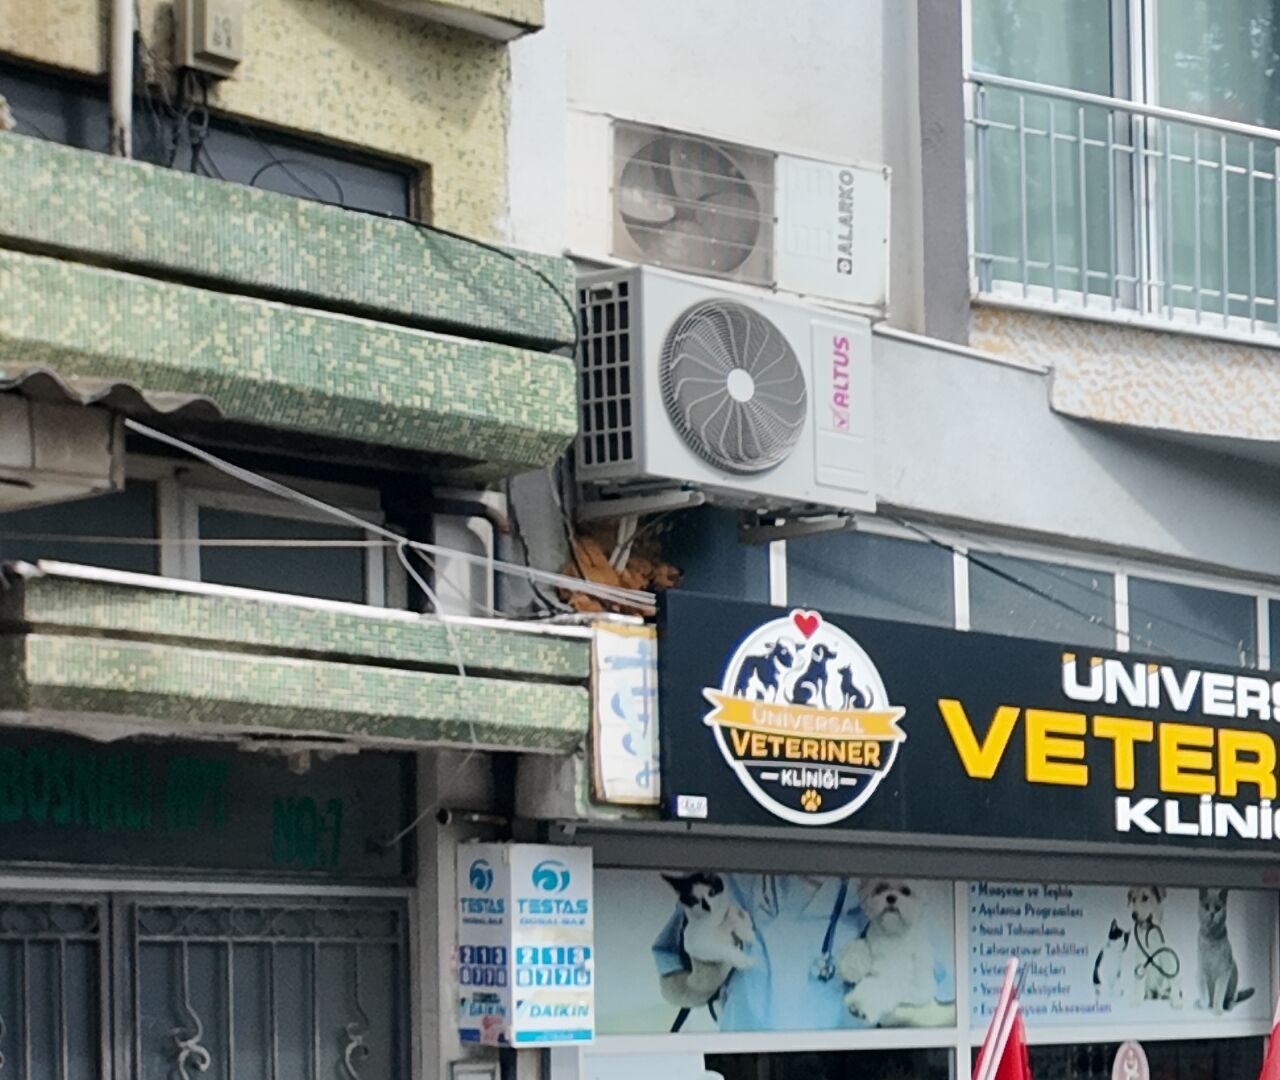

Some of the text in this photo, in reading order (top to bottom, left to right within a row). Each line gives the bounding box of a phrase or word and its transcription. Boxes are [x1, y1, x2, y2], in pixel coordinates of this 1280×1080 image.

[837, 170, 854, 256] ALARKO
[833, 336, 849, 408] ALTUS
[730, 728, 881, 768] VETERİNER
[517, 900, 589, 915] TESTAS
[530, 1002, 589, 1017] DAIKIN
